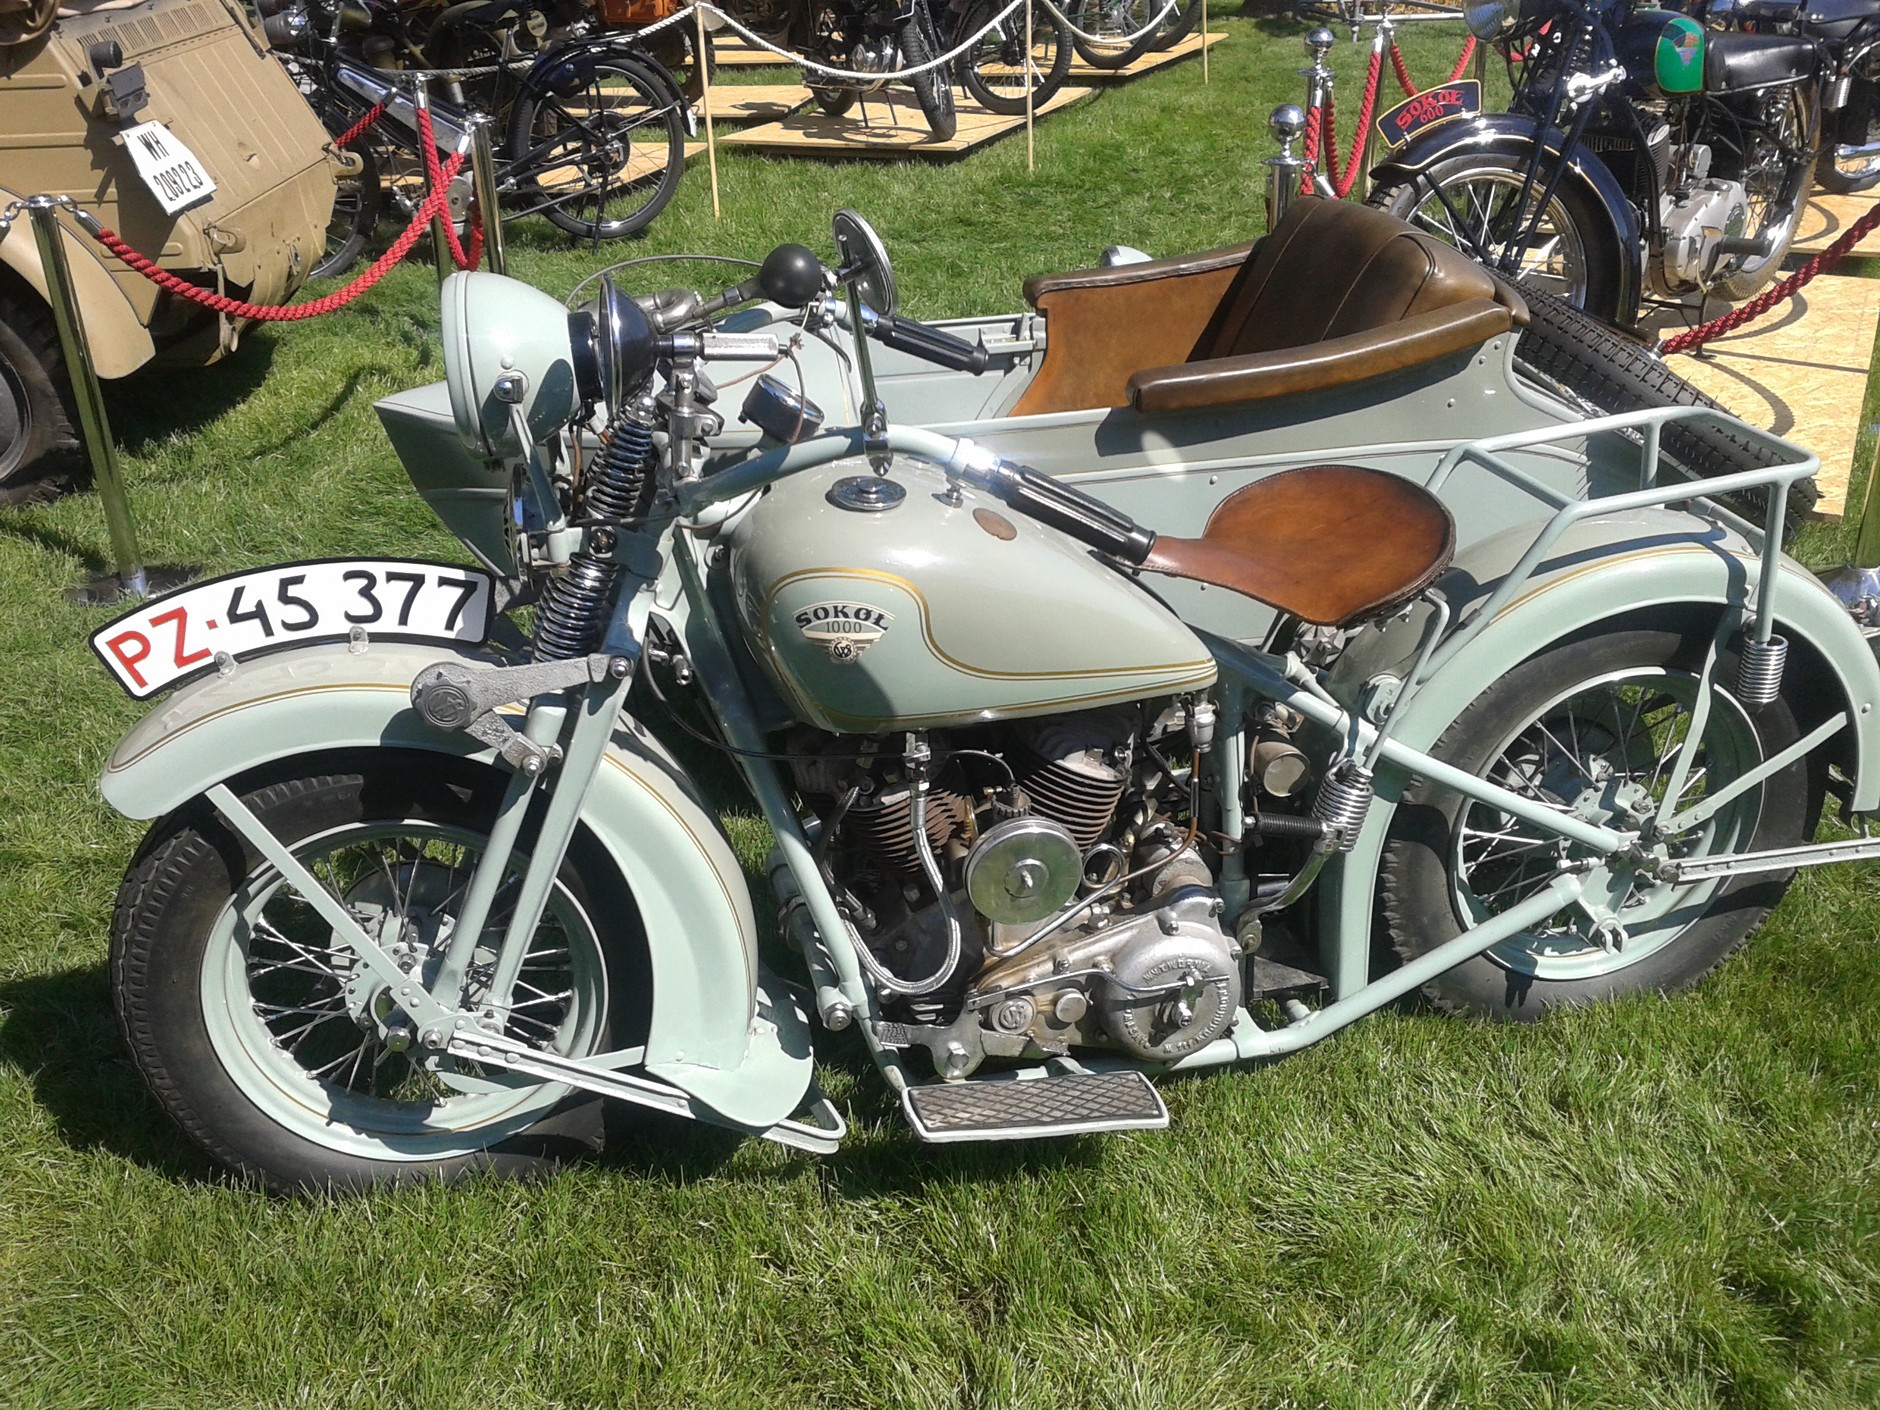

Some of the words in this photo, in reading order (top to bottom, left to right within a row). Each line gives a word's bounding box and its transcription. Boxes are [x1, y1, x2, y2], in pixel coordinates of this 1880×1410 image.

[1419, 105, 1445, 123] 600
[136, 130, 170, 161] WH
[152, 160, 204, 202] 209223
[342, 569, 481, 632] 377
[825, 620, 862, 634] 1000
